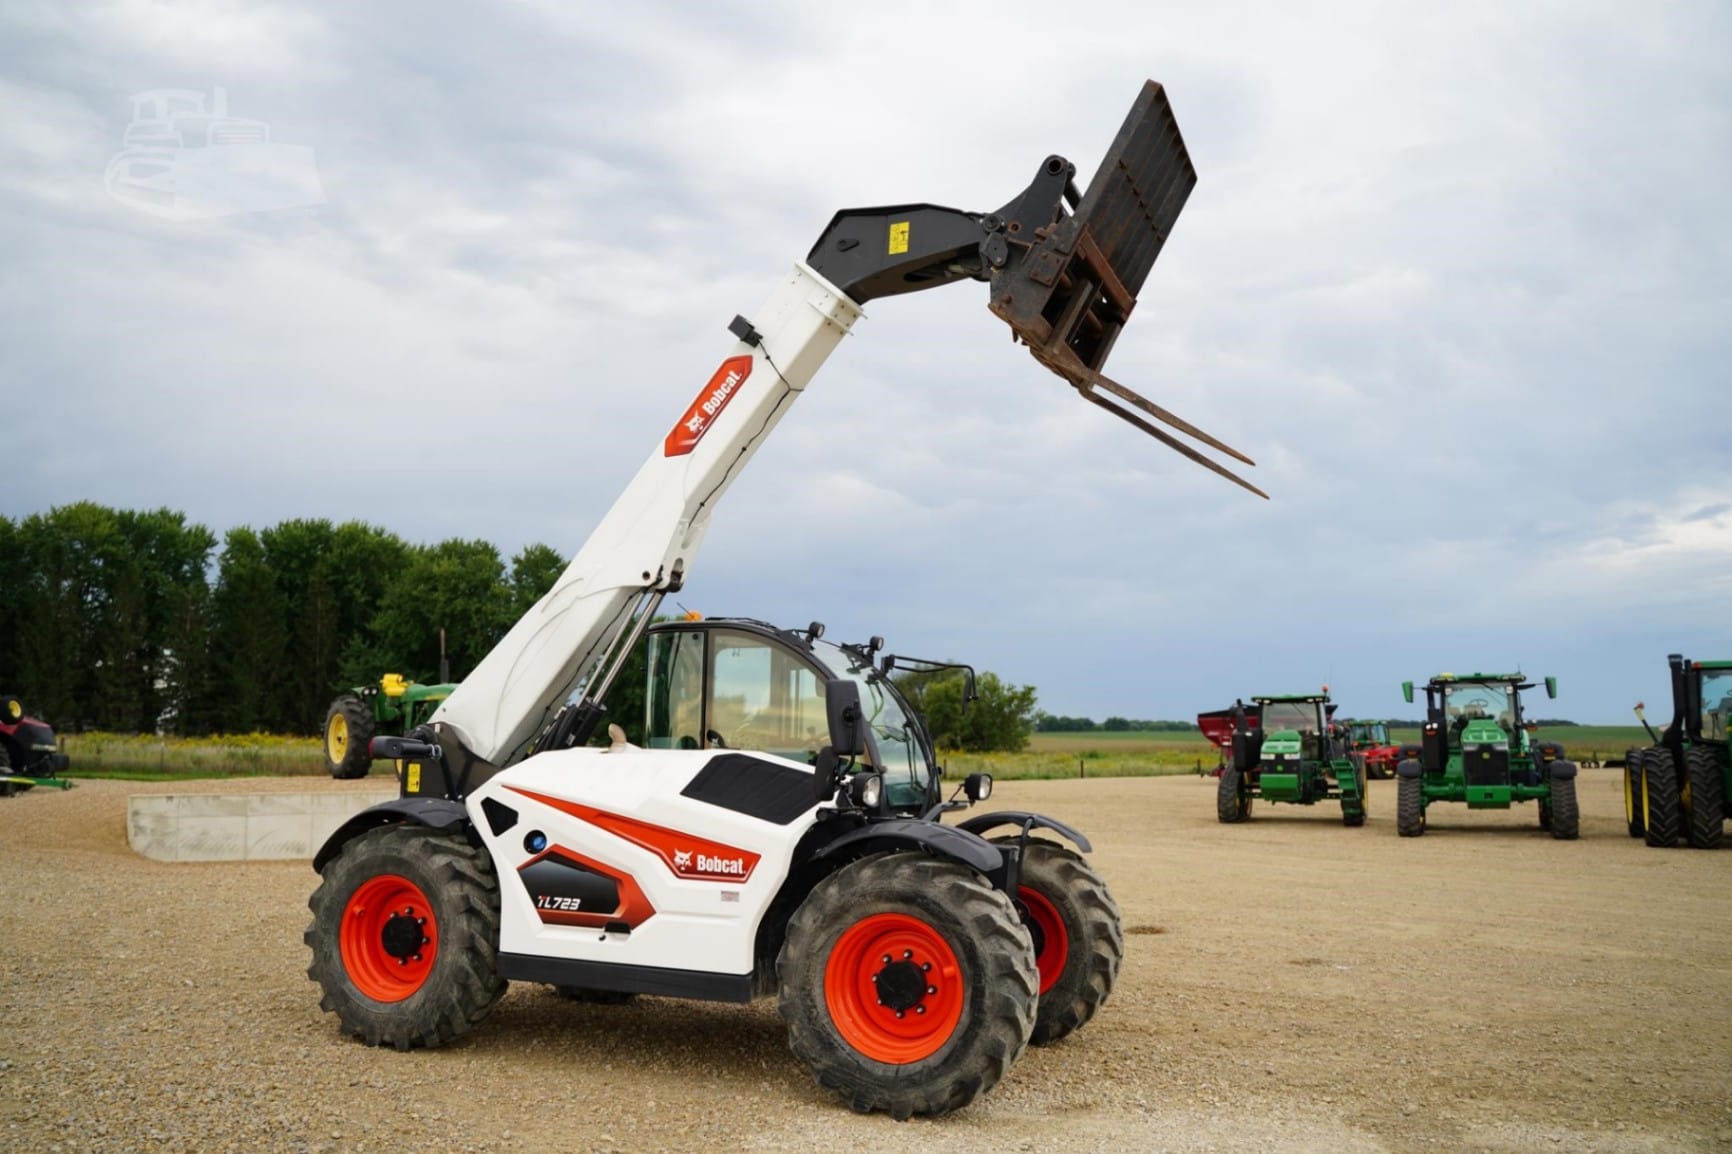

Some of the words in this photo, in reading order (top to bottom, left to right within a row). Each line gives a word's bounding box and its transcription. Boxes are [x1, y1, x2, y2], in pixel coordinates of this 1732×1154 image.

[702, 370, 741, 415] Bobcat
[697, 854, 744, 874] Bobcat
[538, 896, 581, 910] TL723
